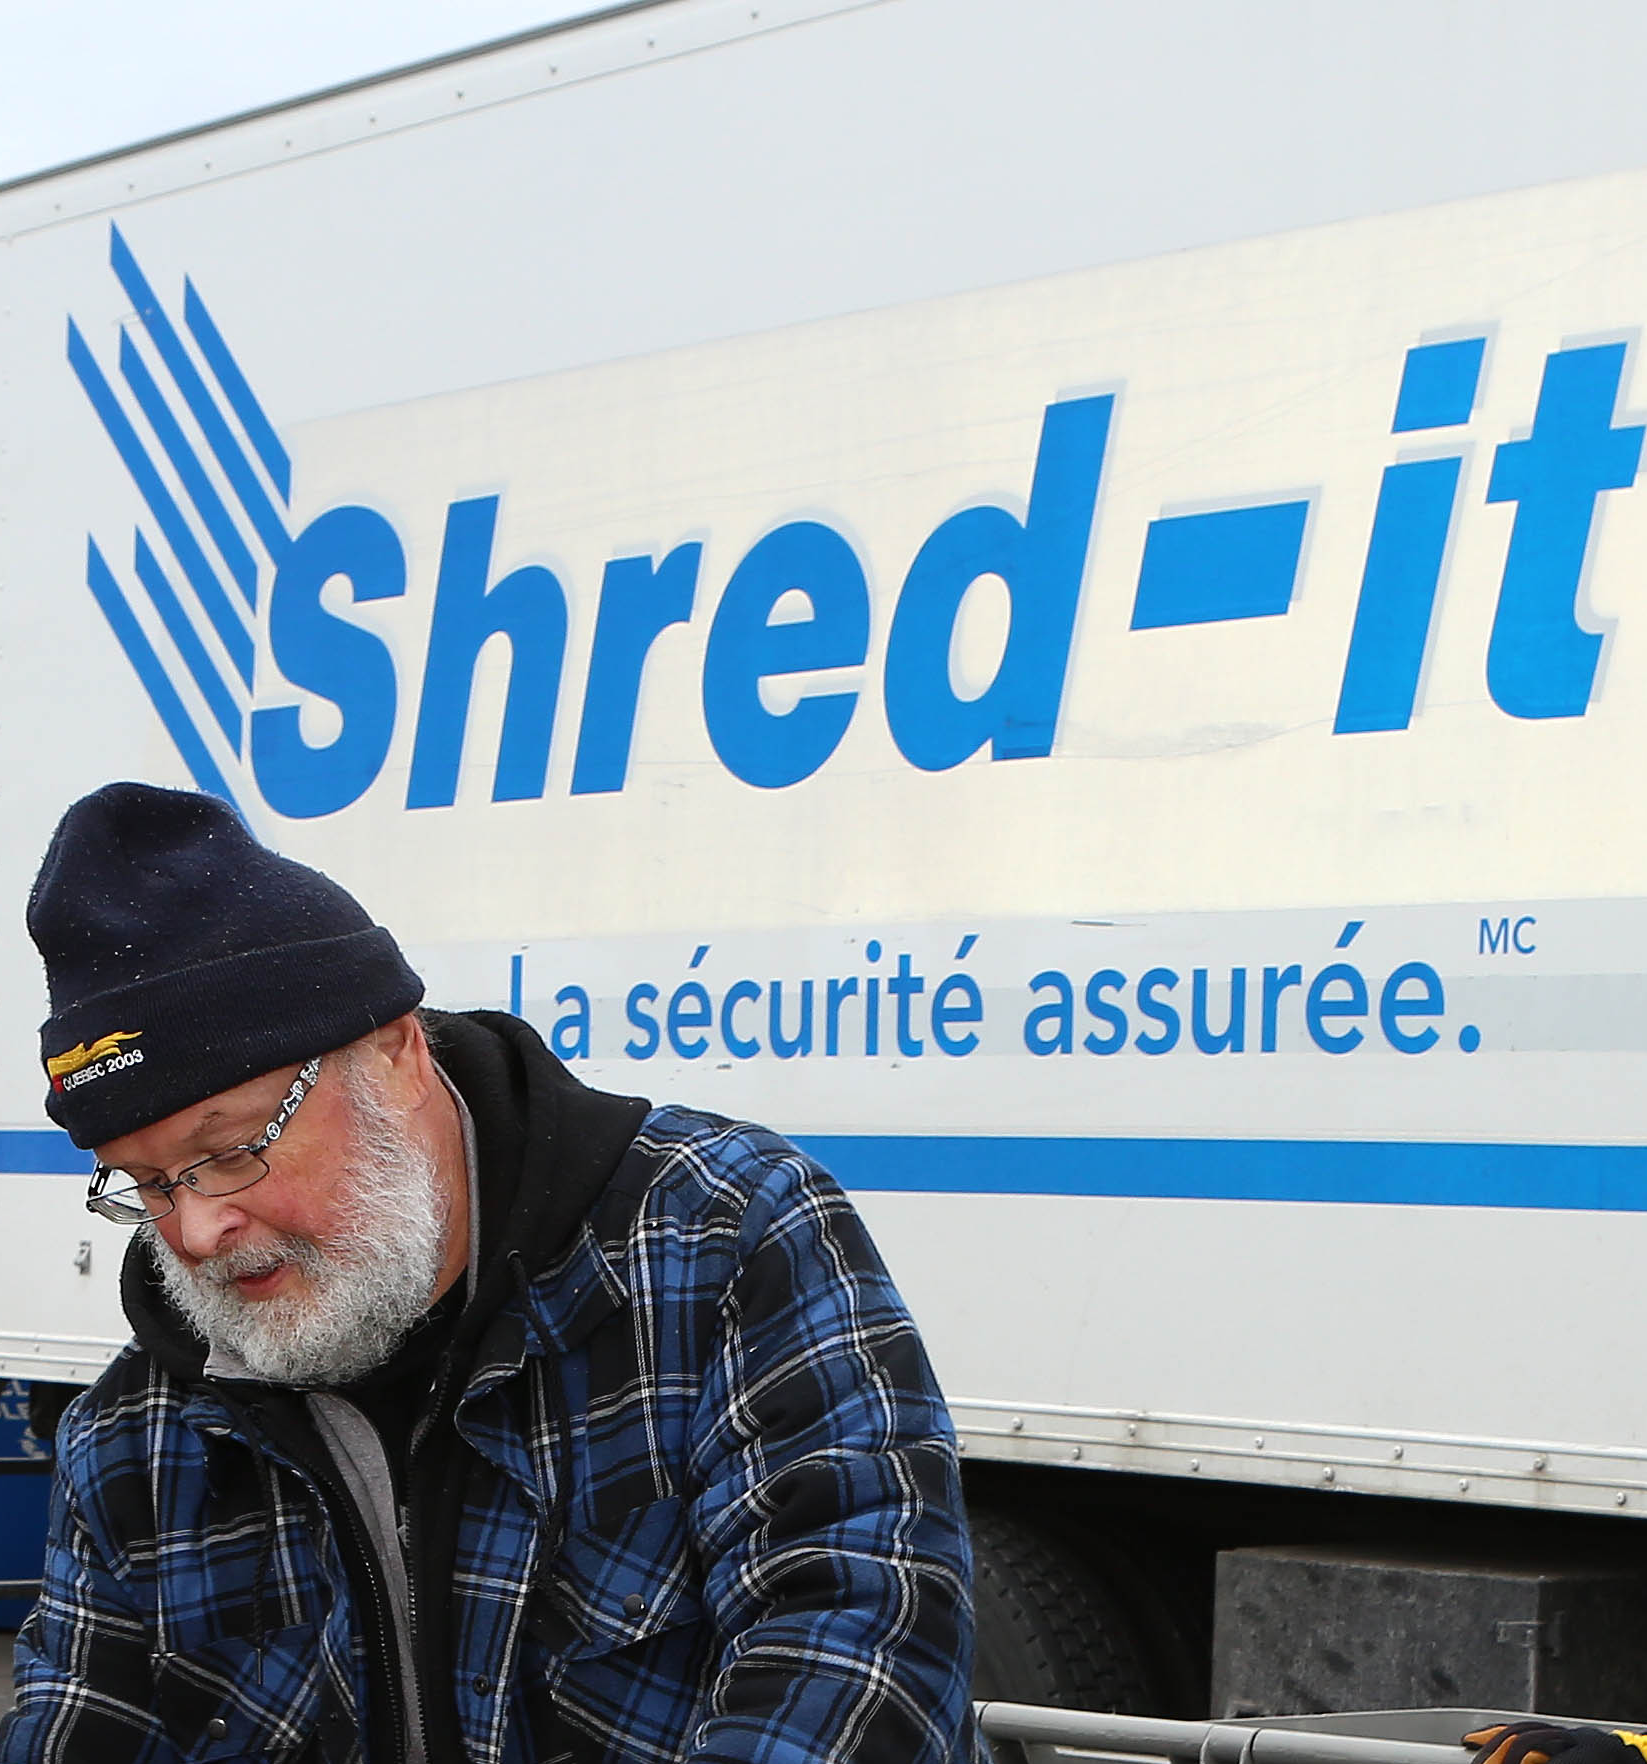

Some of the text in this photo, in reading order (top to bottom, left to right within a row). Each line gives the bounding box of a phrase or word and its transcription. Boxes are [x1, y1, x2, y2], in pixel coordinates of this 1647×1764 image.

[250, 337, 1647, 820] Shred-it
[624, 933, 984, 1061] sécurité
[1023, 920, 1482, 1057] assurée.
[1478, 916, 1537, 955] MC
[62, 1049, 144, 1092] QUEBEC 2003
